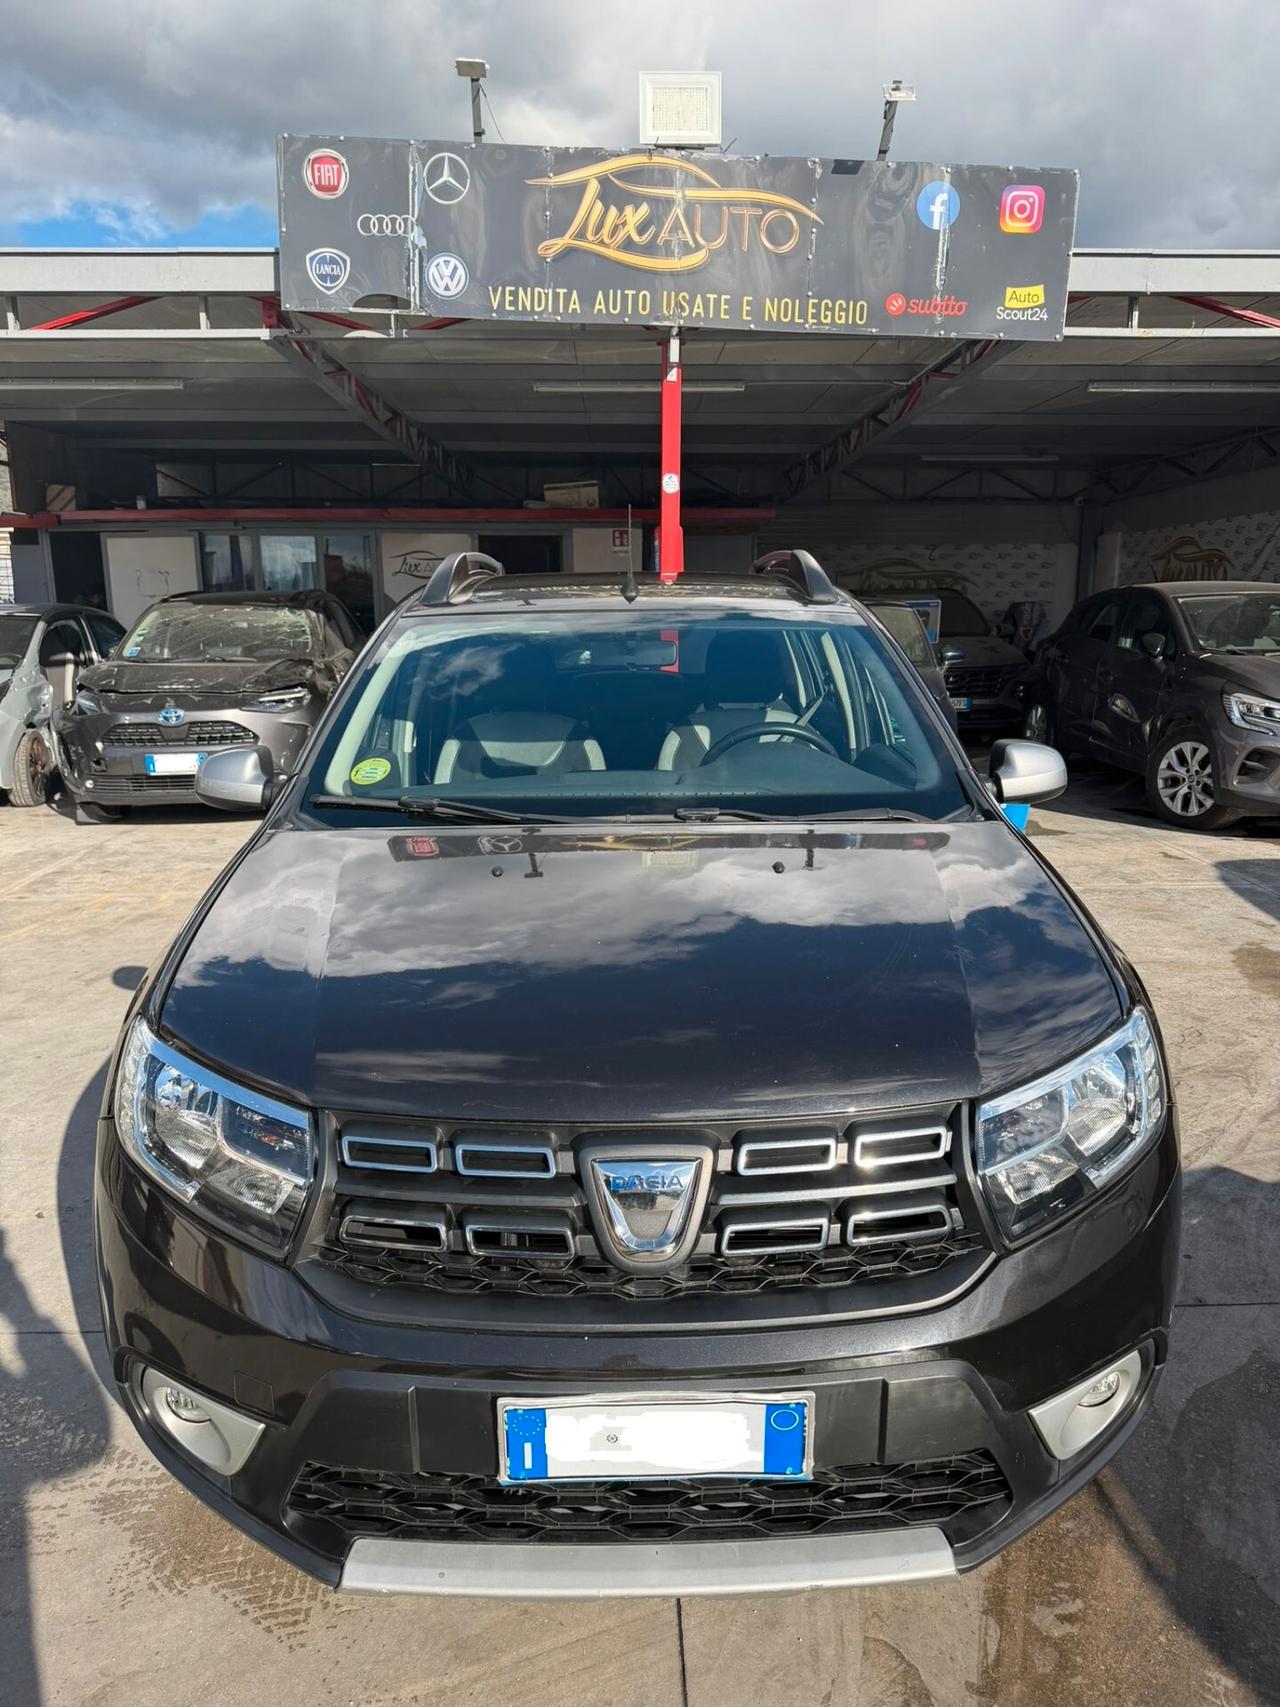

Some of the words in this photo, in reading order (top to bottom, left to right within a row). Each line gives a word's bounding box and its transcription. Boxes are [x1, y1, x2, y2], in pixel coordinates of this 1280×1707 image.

[313, 163, 340, 186] FIAT
[538, 177, 656, 257] Lux
[656, 203, 800, 254] AUTO
[315, 263, 342, 276] LANCIA
[488, 285, 581, 314] VENDITA
[593, 289, 651, 315] AUTO
[662, 290, 731, 319] USATE
[742, 296, 753, 320] E
[764, 297, 868, 325] NOLEGGIO
[1008, 290, 1040, 304] Auto
[996, 306, 1048, 321] Scout24
[610, 1175, 684, 1191] DACIA
